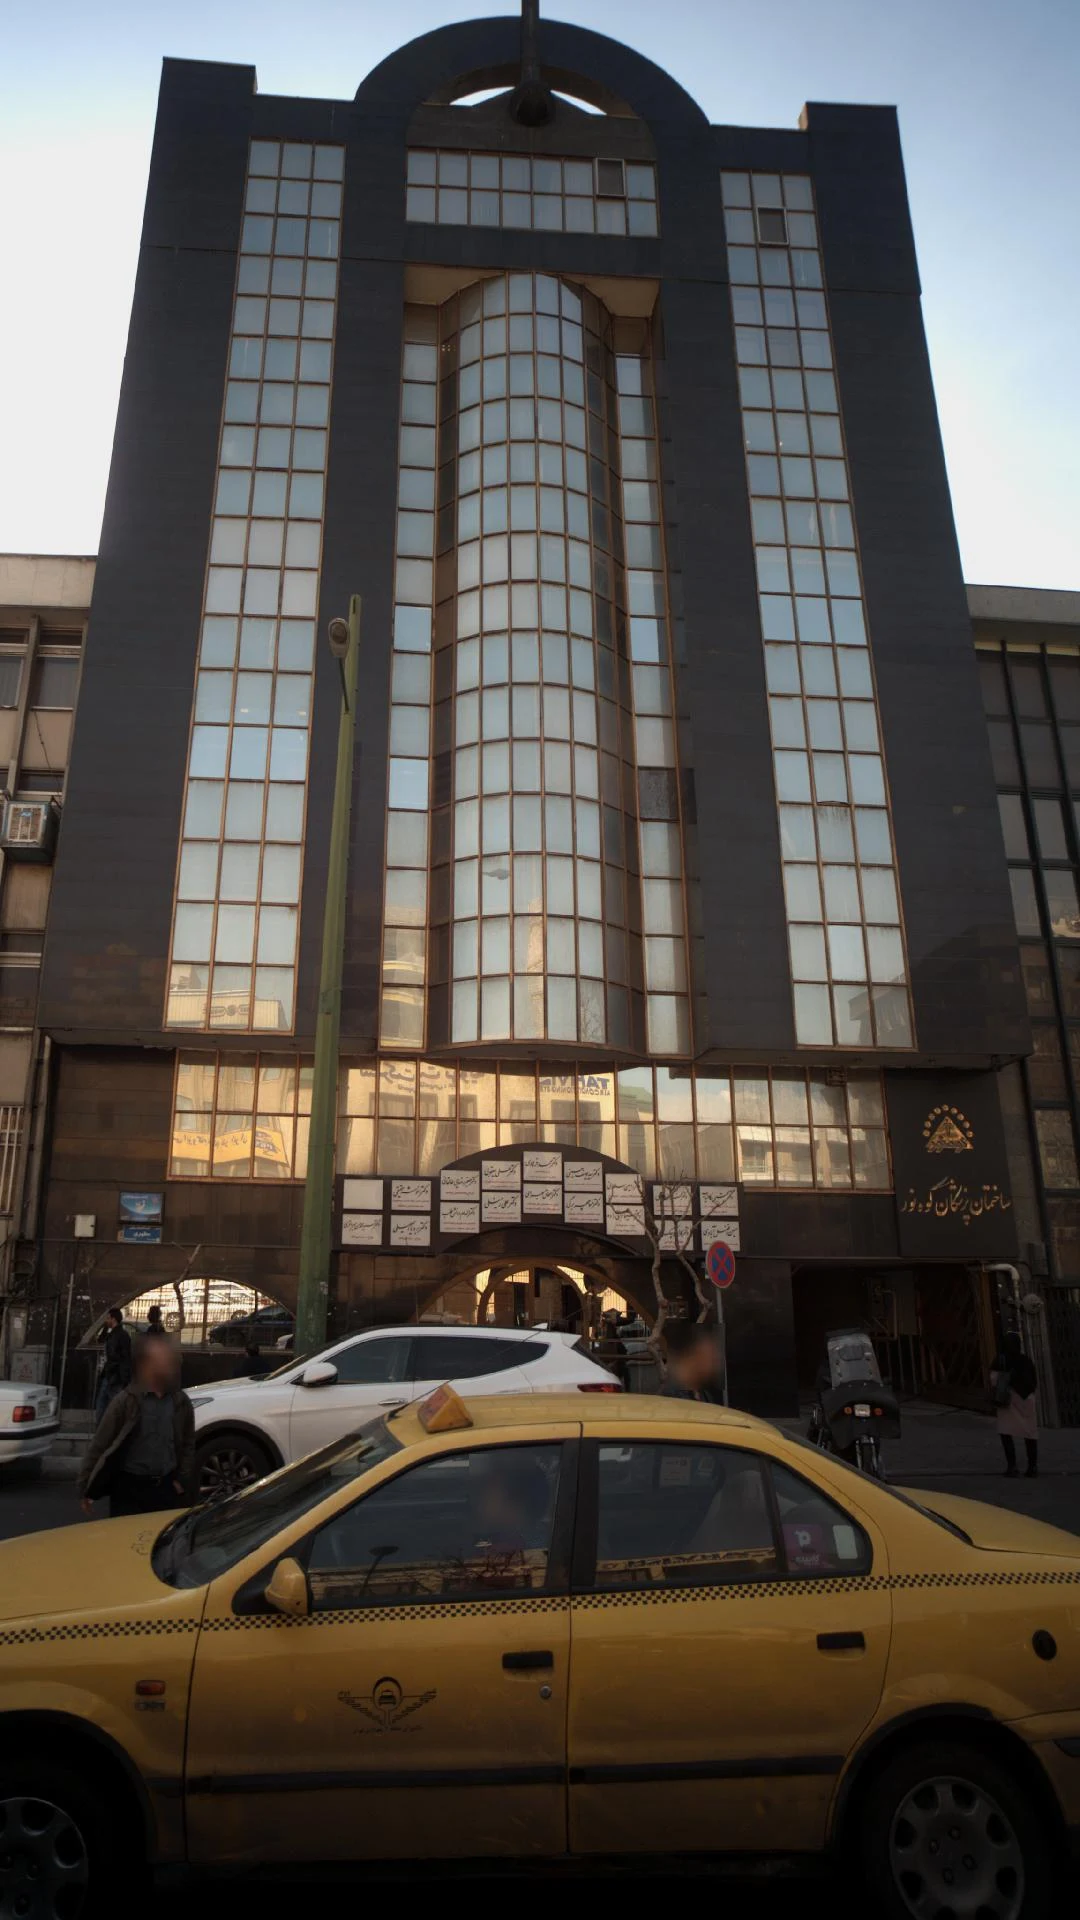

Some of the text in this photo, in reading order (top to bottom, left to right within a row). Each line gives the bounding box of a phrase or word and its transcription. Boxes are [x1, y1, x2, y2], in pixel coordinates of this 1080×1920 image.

[900, 1187, 917, 1213] نور
[935, 1178, 970, 1226] پزشکان
[969, 1184, 1012, 1216] ساختمان
